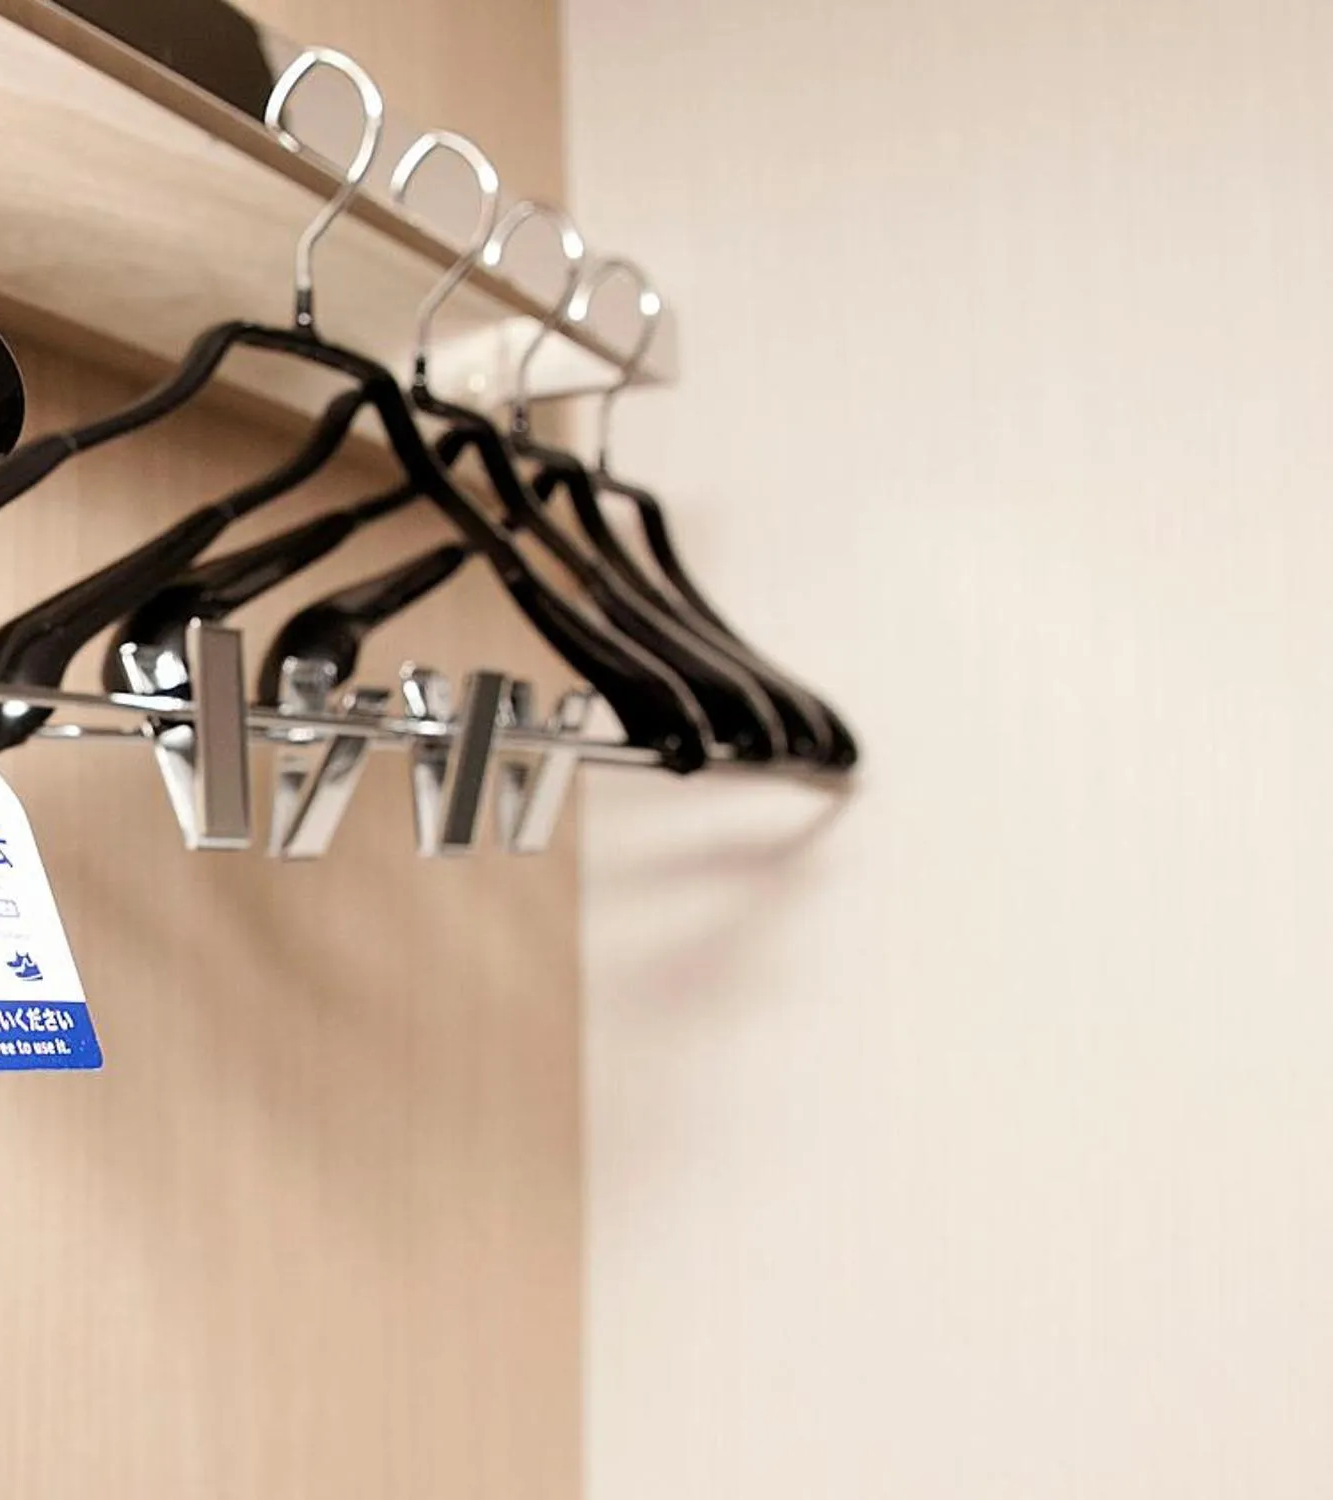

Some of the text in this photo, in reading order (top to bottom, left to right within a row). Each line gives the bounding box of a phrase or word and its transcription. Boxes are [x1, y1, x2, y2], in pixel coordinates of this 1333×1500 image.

[17, 1039, 32, 1055] to
[33, 1042, 56, 1055] use
[55, 1038, 72, 1055] it.
